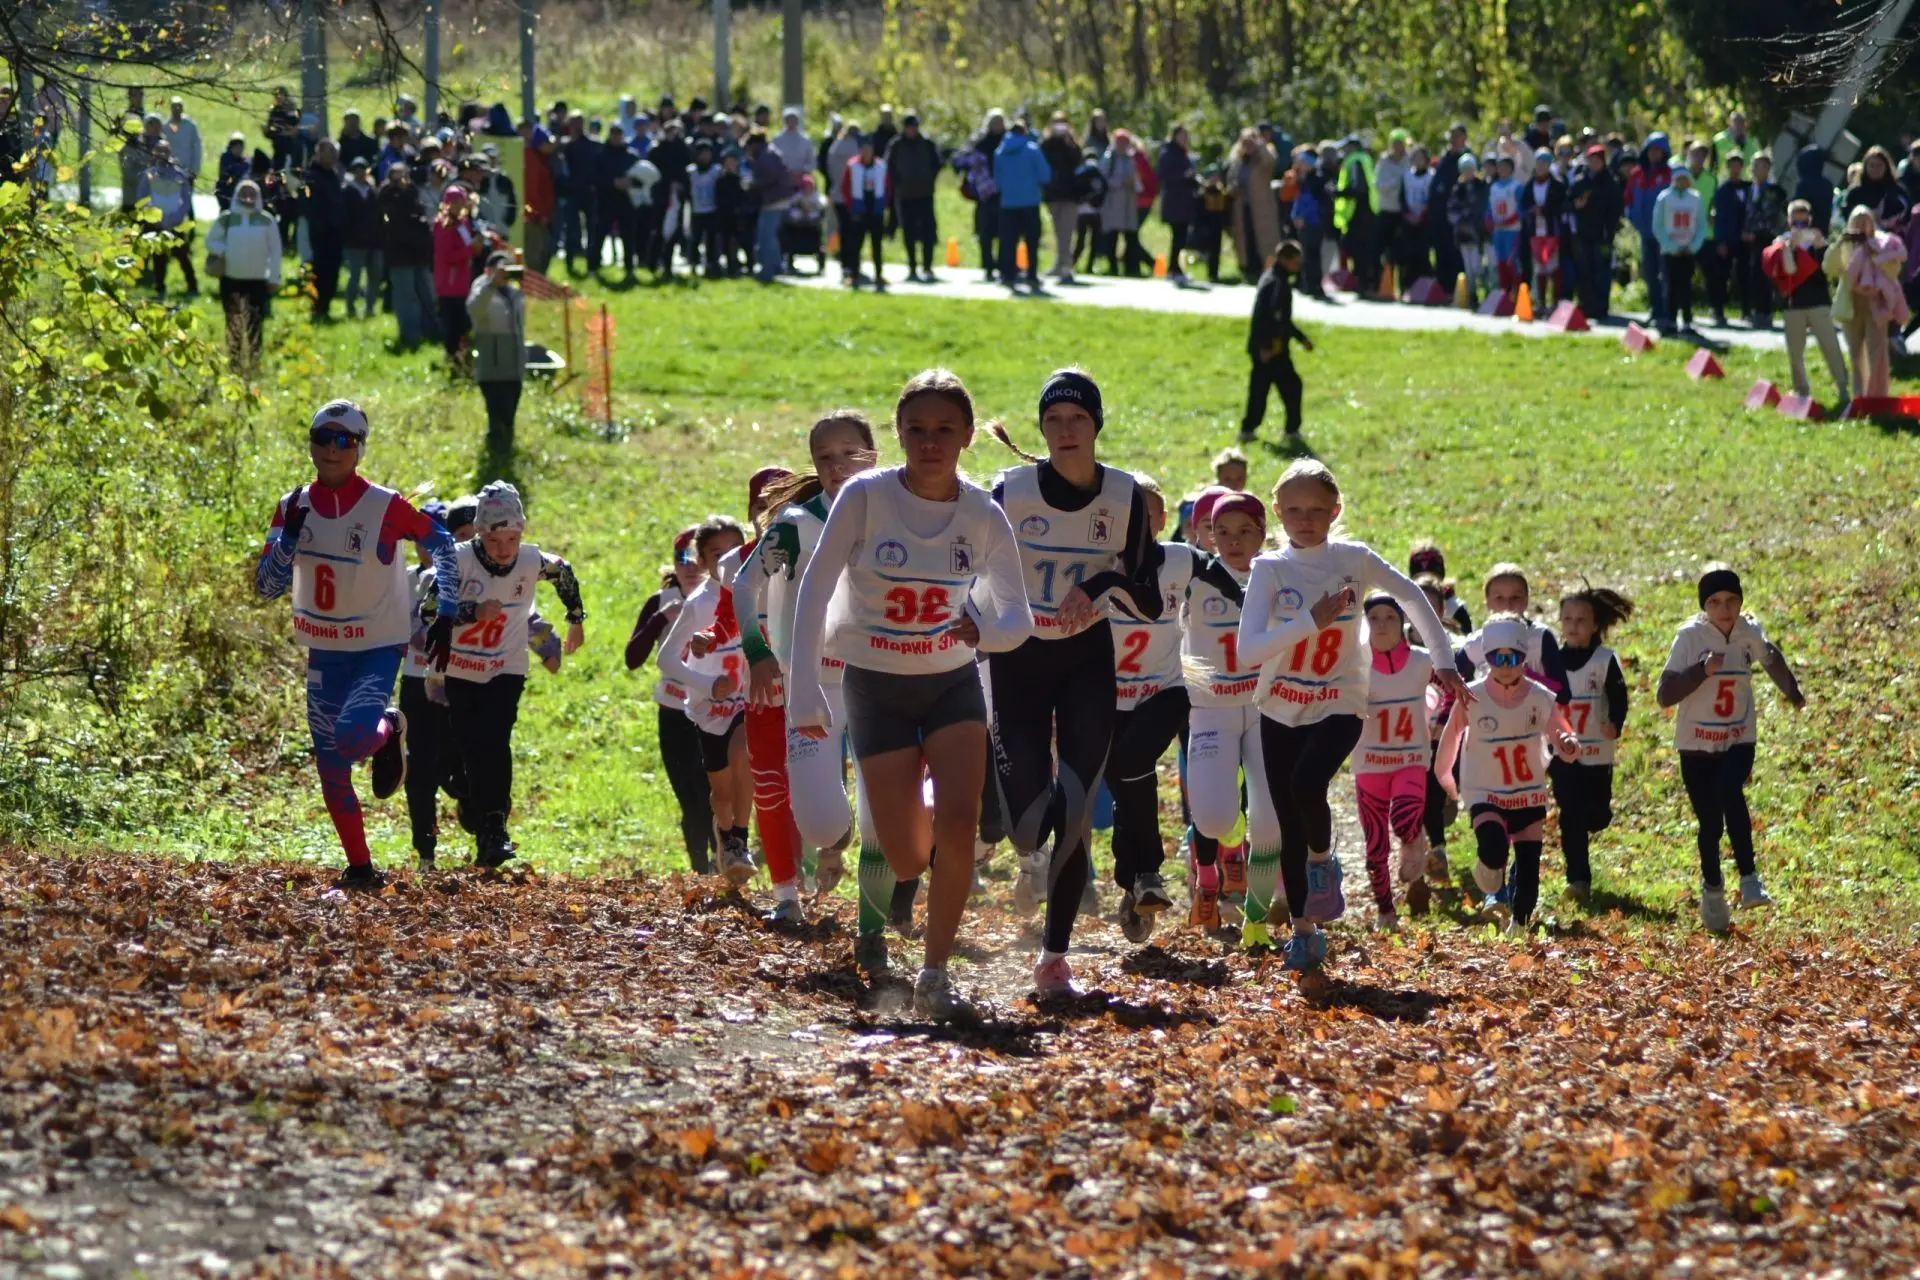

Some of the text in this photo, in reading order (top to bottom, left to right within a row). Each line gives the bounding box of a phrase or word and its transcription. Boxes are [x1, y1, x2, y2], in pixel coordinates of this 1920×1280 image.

[1044, 388, 1082, 402] LUKOIL
[314, 563, 335, 611] 6
[1034, 559, 1087, 602] 11
[884, 586, 952, 624] 32
[293, 615, 365, 639] Марий Эл
[456, 611, 507, 649] 26
[870, 635, 933, 655] Марий
[1116, 629, 1151, 674] 2
[1290, 626, 1343, 677] 18
[1713, 679, 1737, 718] 5
[1376, 706, 1414, 743] 14
[1365, 752, 1423, 765] Марий Эл
[1492, 743, 1534, 785] 16
[1531, 792, 1547, 805] Эл
